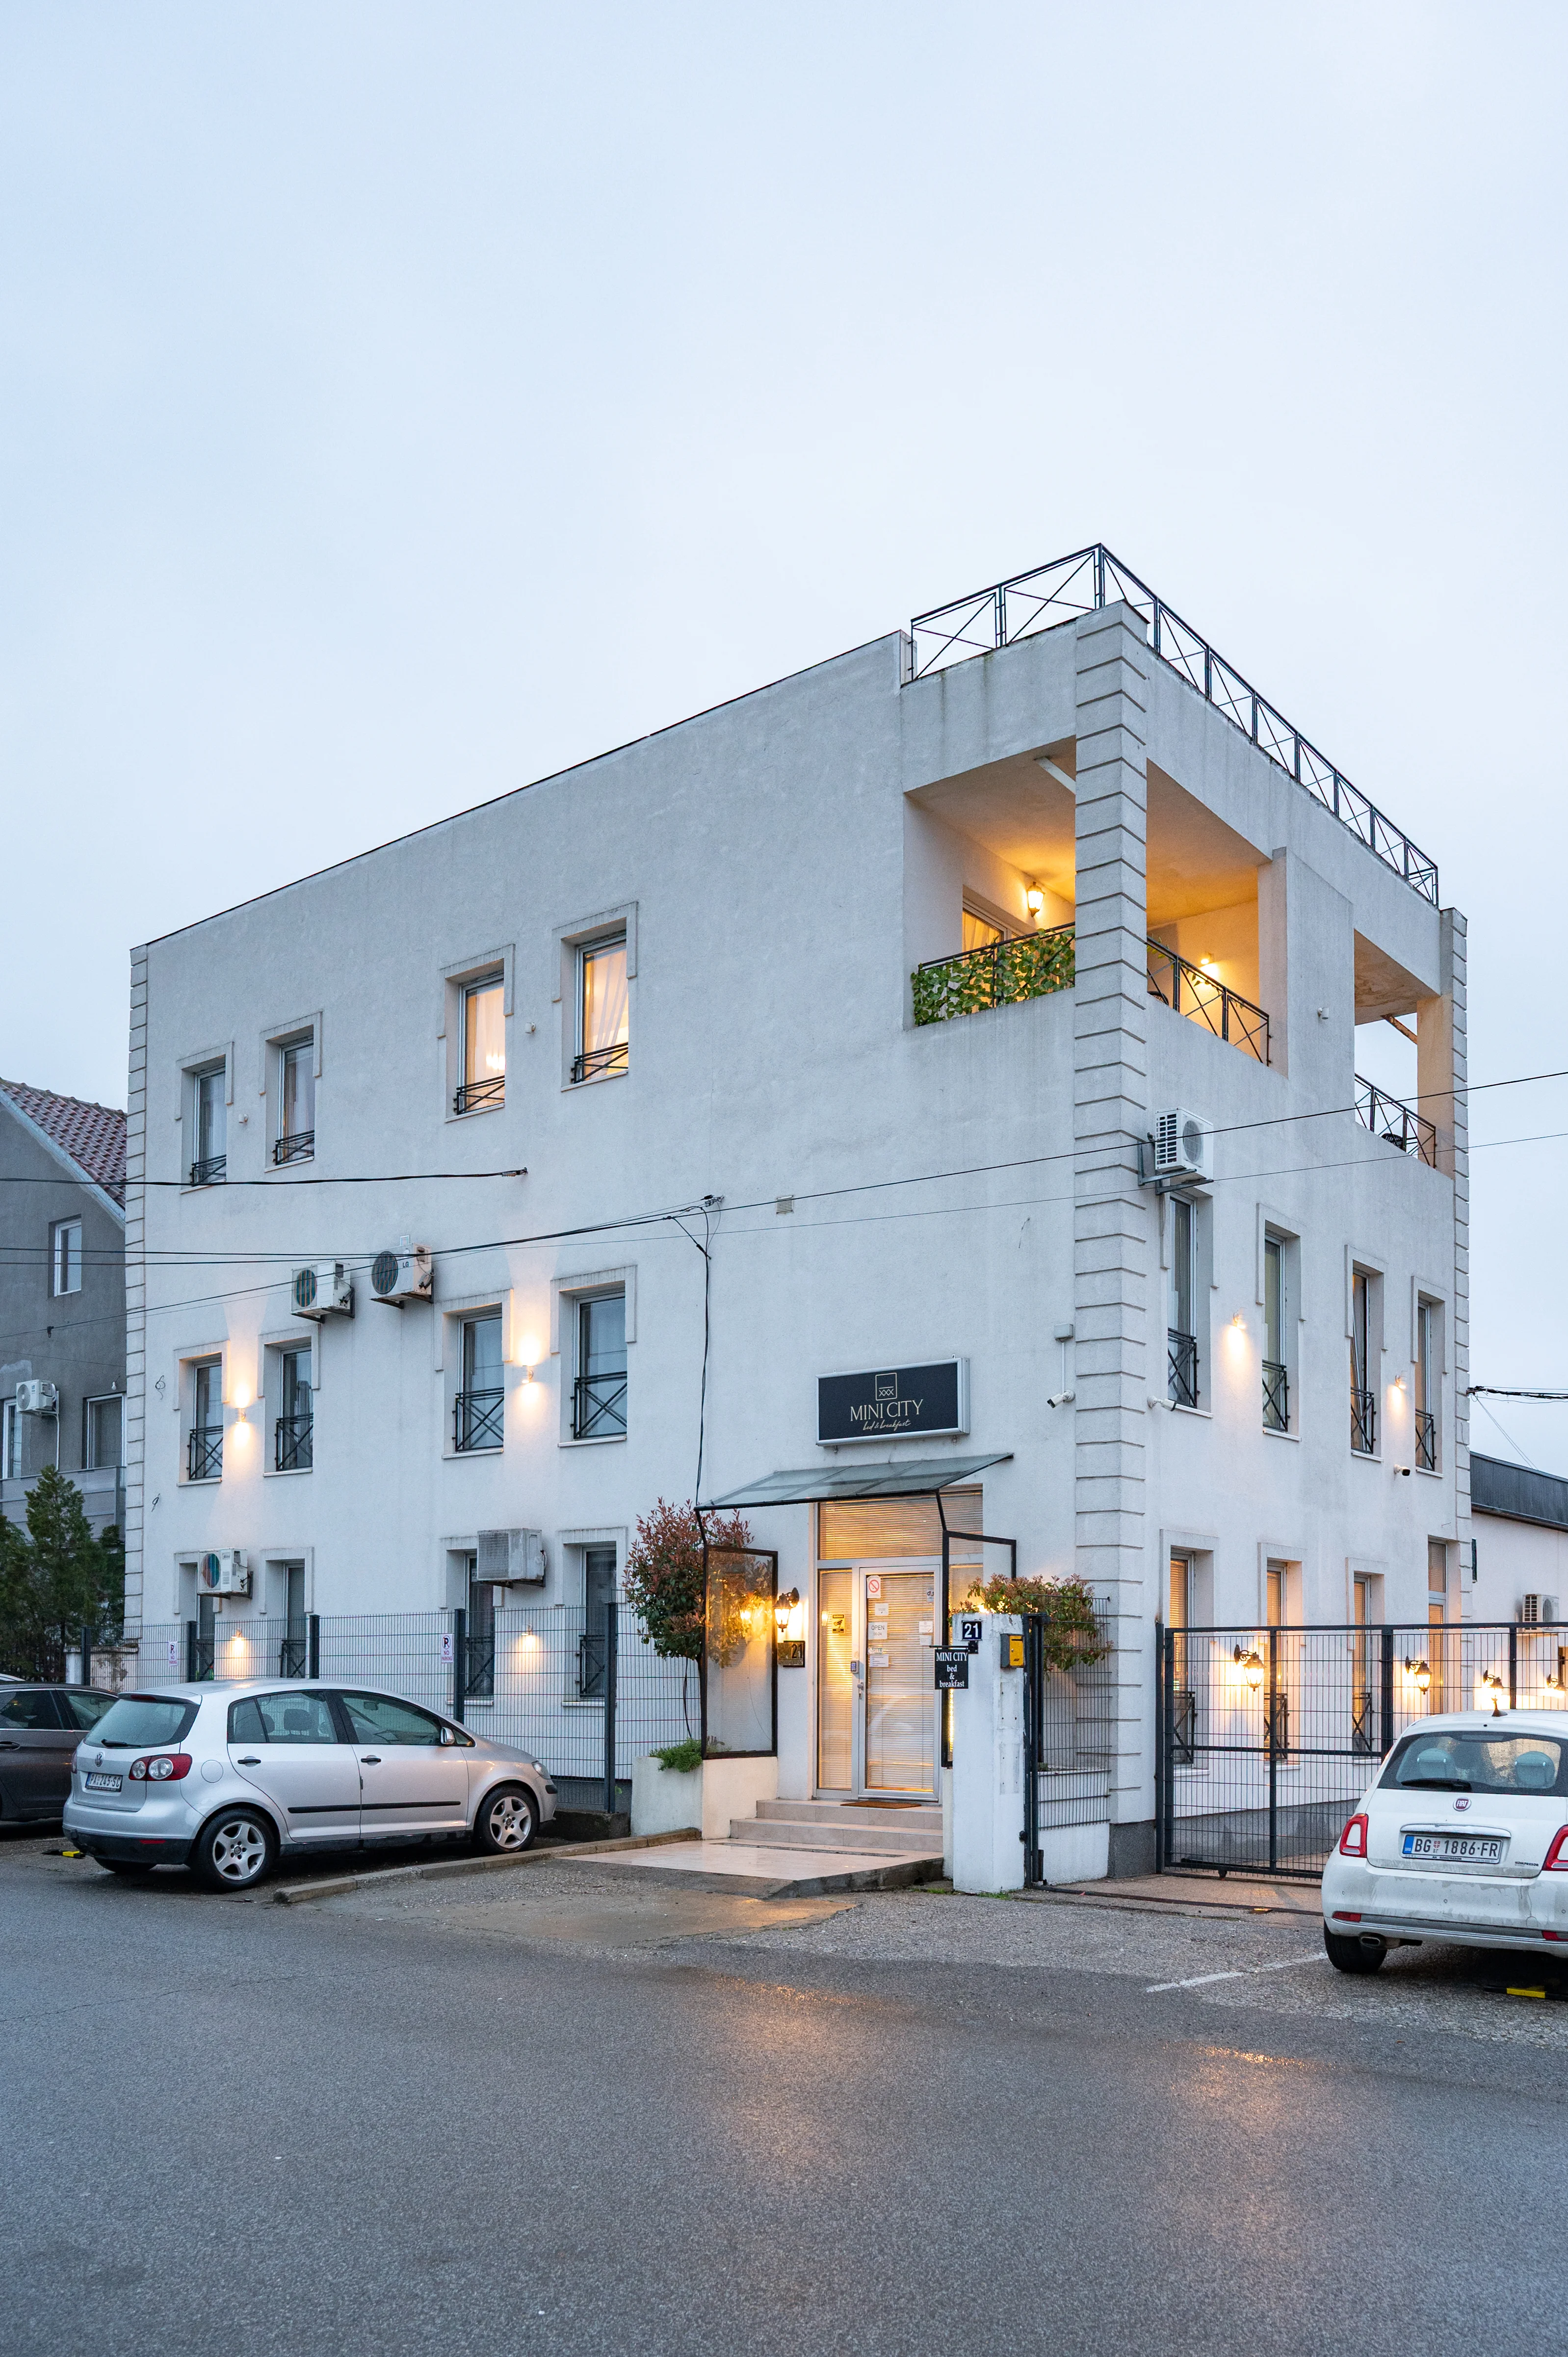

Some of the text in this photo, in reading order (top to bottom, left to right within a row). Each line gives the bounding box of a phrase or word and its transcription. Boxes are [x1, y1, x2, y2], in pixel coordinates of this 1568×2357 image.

[850, 1399, 923, 1421] MINI CITY
[862, 1421, 875, 1431] bed
[880, 1419, 911, 1431] breakfast
[964, 1623, 978, 1638] 21
[792, 1644, 802, 1658] 21
[936, 1652, 967, 1661] MINI CITY
[1414, 1838, 1431, 1853] BG
